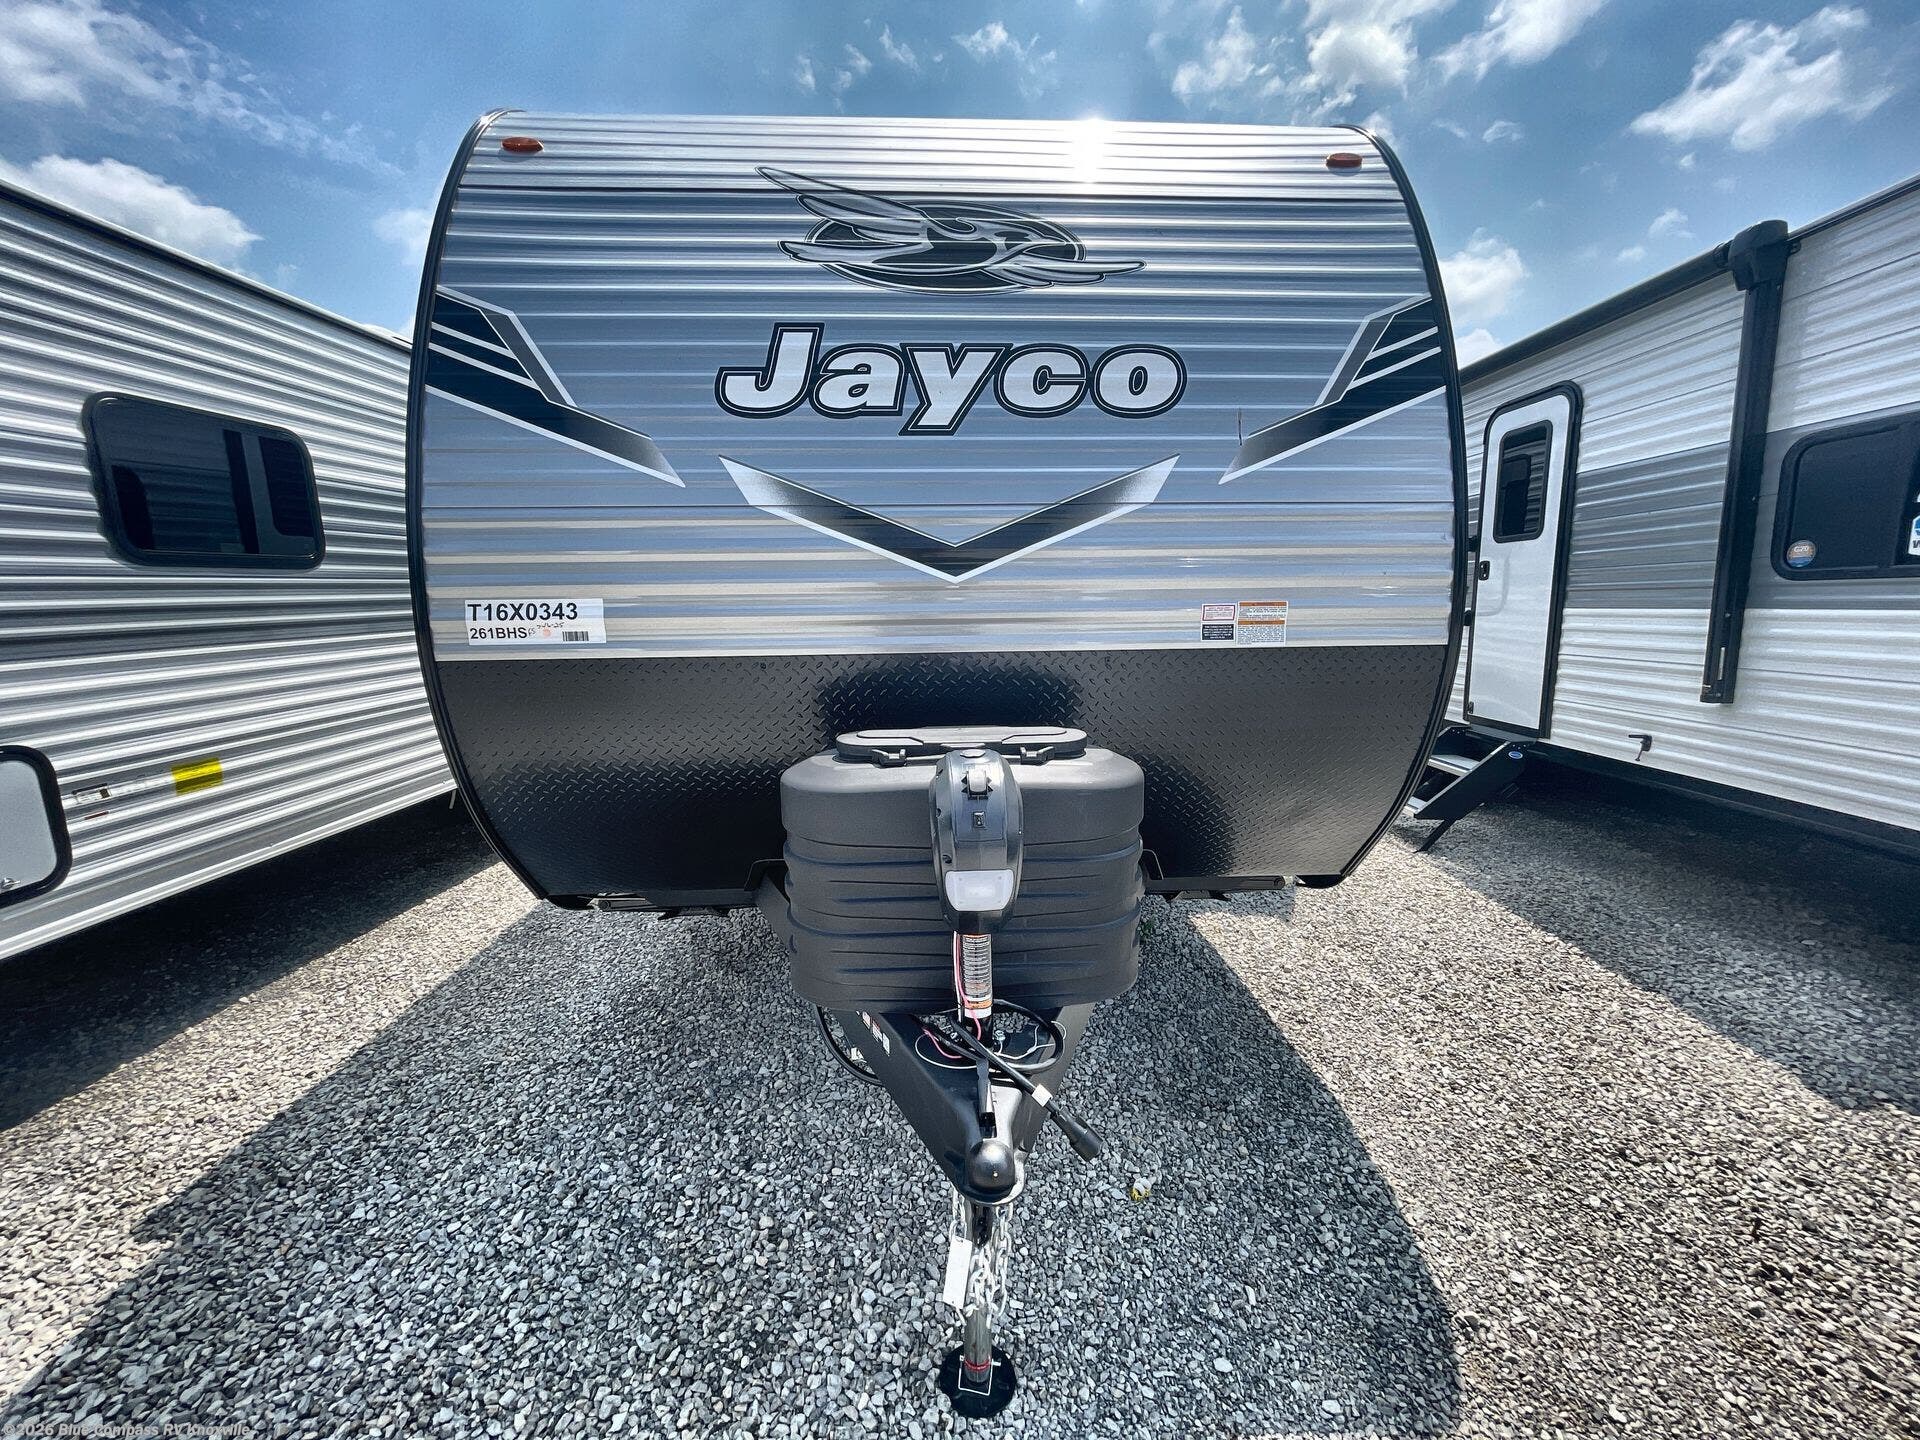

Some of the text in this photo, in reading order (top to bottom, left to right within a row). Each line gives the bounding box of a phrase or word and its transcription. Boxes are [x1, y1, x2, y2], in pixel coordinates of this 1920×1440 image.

[714, 322, 1188, 436] Jayco
[467, 603, 578, 621] T16X0343
[469, 627, 527, 639] 261BHS
